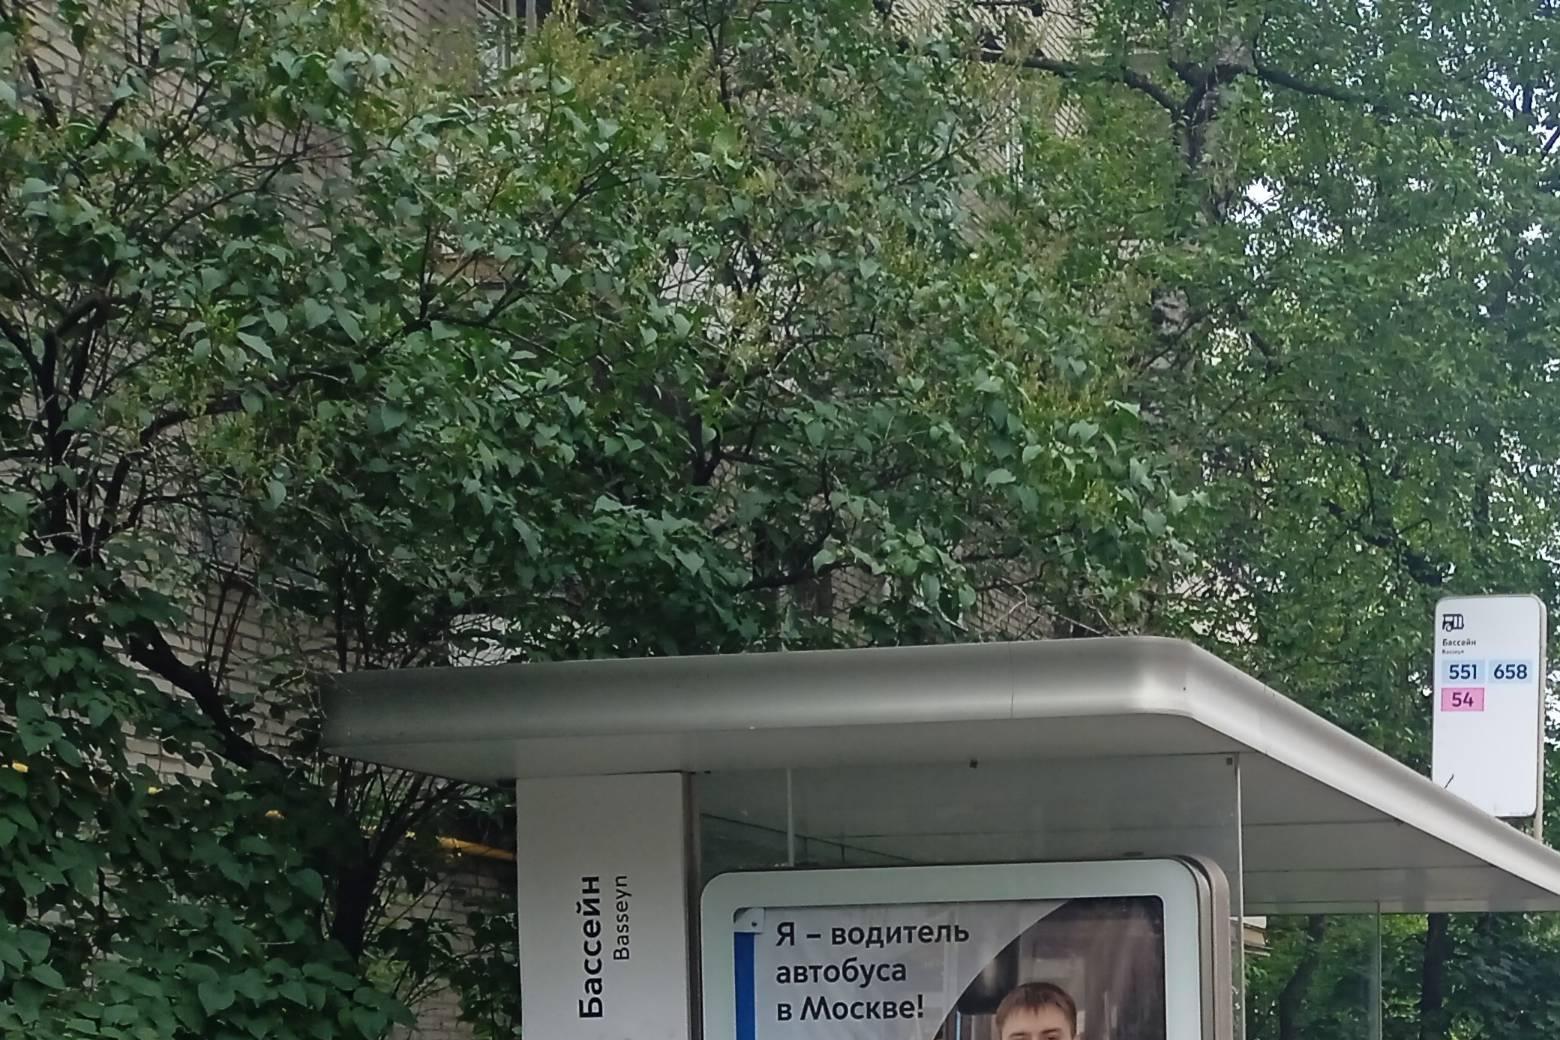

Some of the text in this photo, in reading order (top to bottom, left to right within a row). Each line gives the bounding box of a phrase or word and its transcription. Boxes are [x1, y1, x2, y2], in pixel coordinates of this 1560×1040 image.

[1449, 664, 1528, 680] 551 658
[1451, 692, 1474, 707] 54
[613, 874, 633, 961] Basseyn
[576, 876, 603, 1018] Бассейн
[776, 922, 795, 946] Я
[831, 924, 970, 948] водитель
[776, 957, 906, 988] автобуса
[777, 994, 924, 1020] в Москве!
